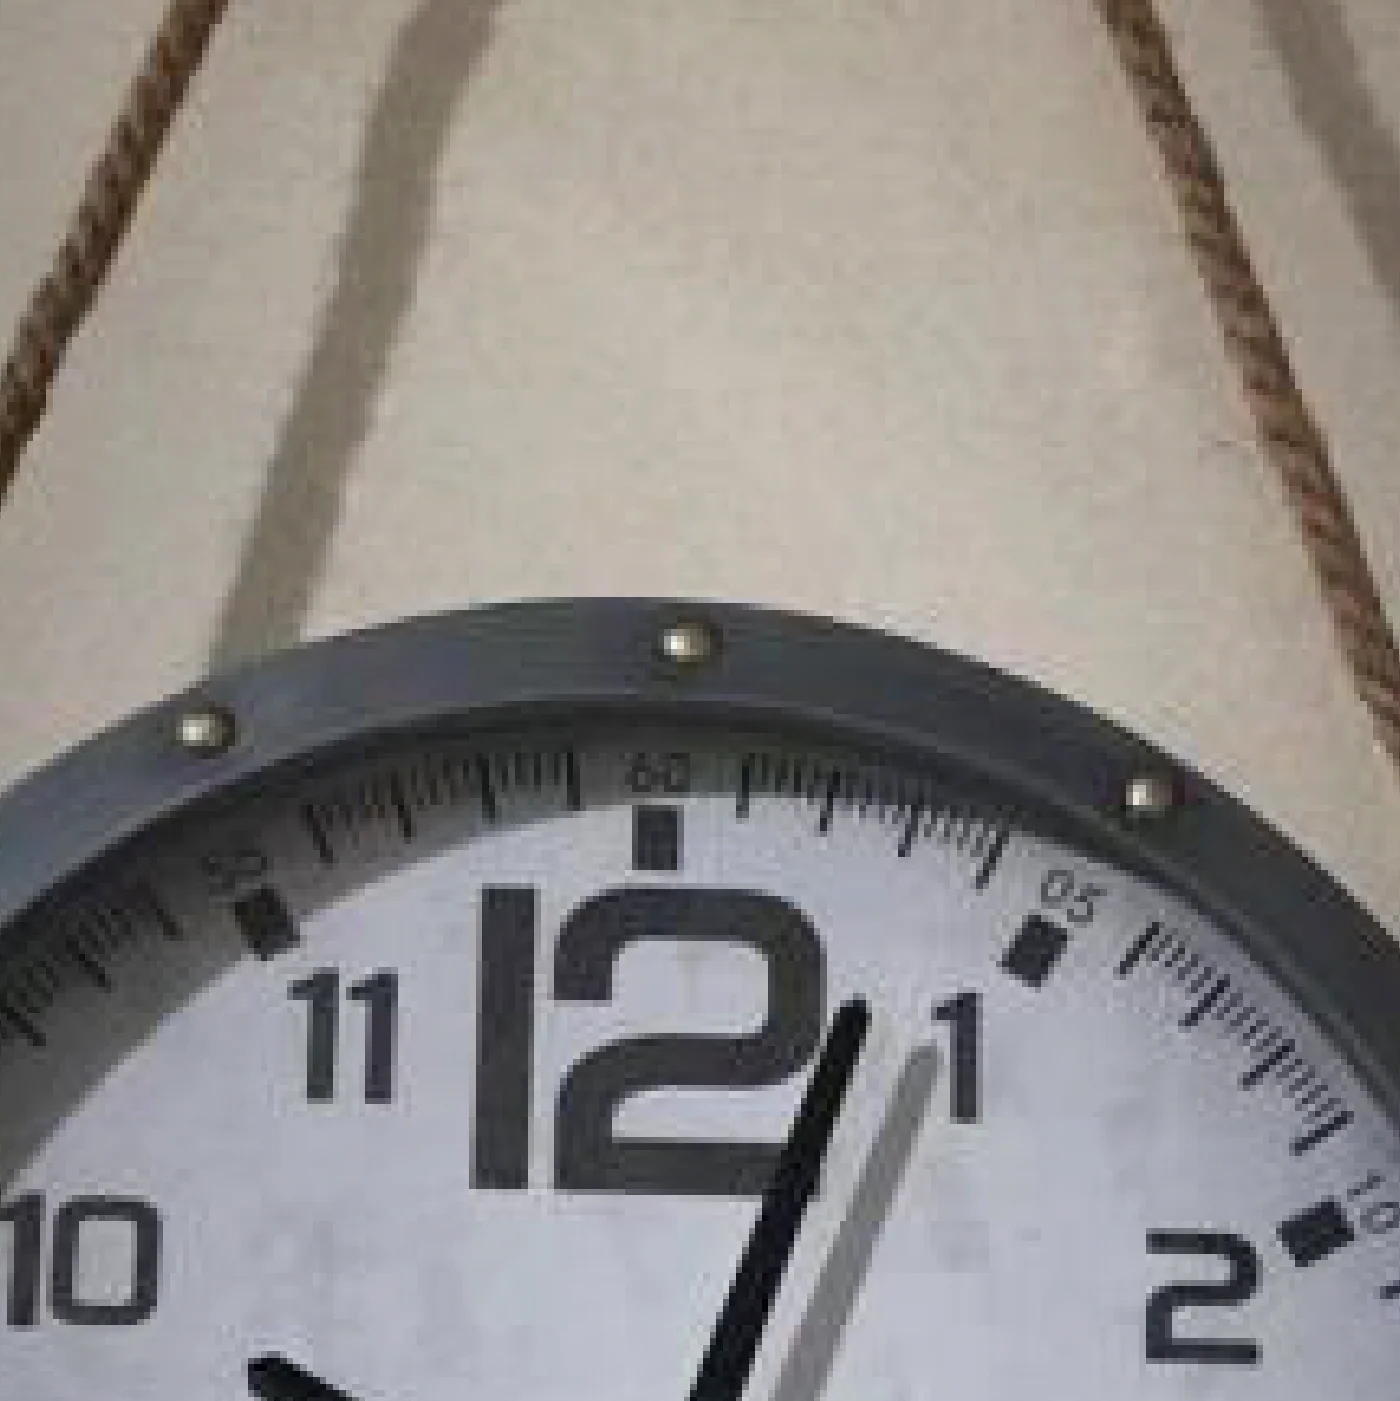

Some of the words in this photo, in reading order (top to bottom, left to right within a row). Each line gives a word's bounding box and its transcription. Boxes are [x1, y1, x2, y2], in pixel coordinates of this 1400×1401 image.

[1039, 868, 1099, 924] 05
[287, 967, 398, 1104] 11
[468, 888, 829, 1194] 12
[931, 993, 979, 1125] 1
[1146, 1230, 1263, 1365] 2
